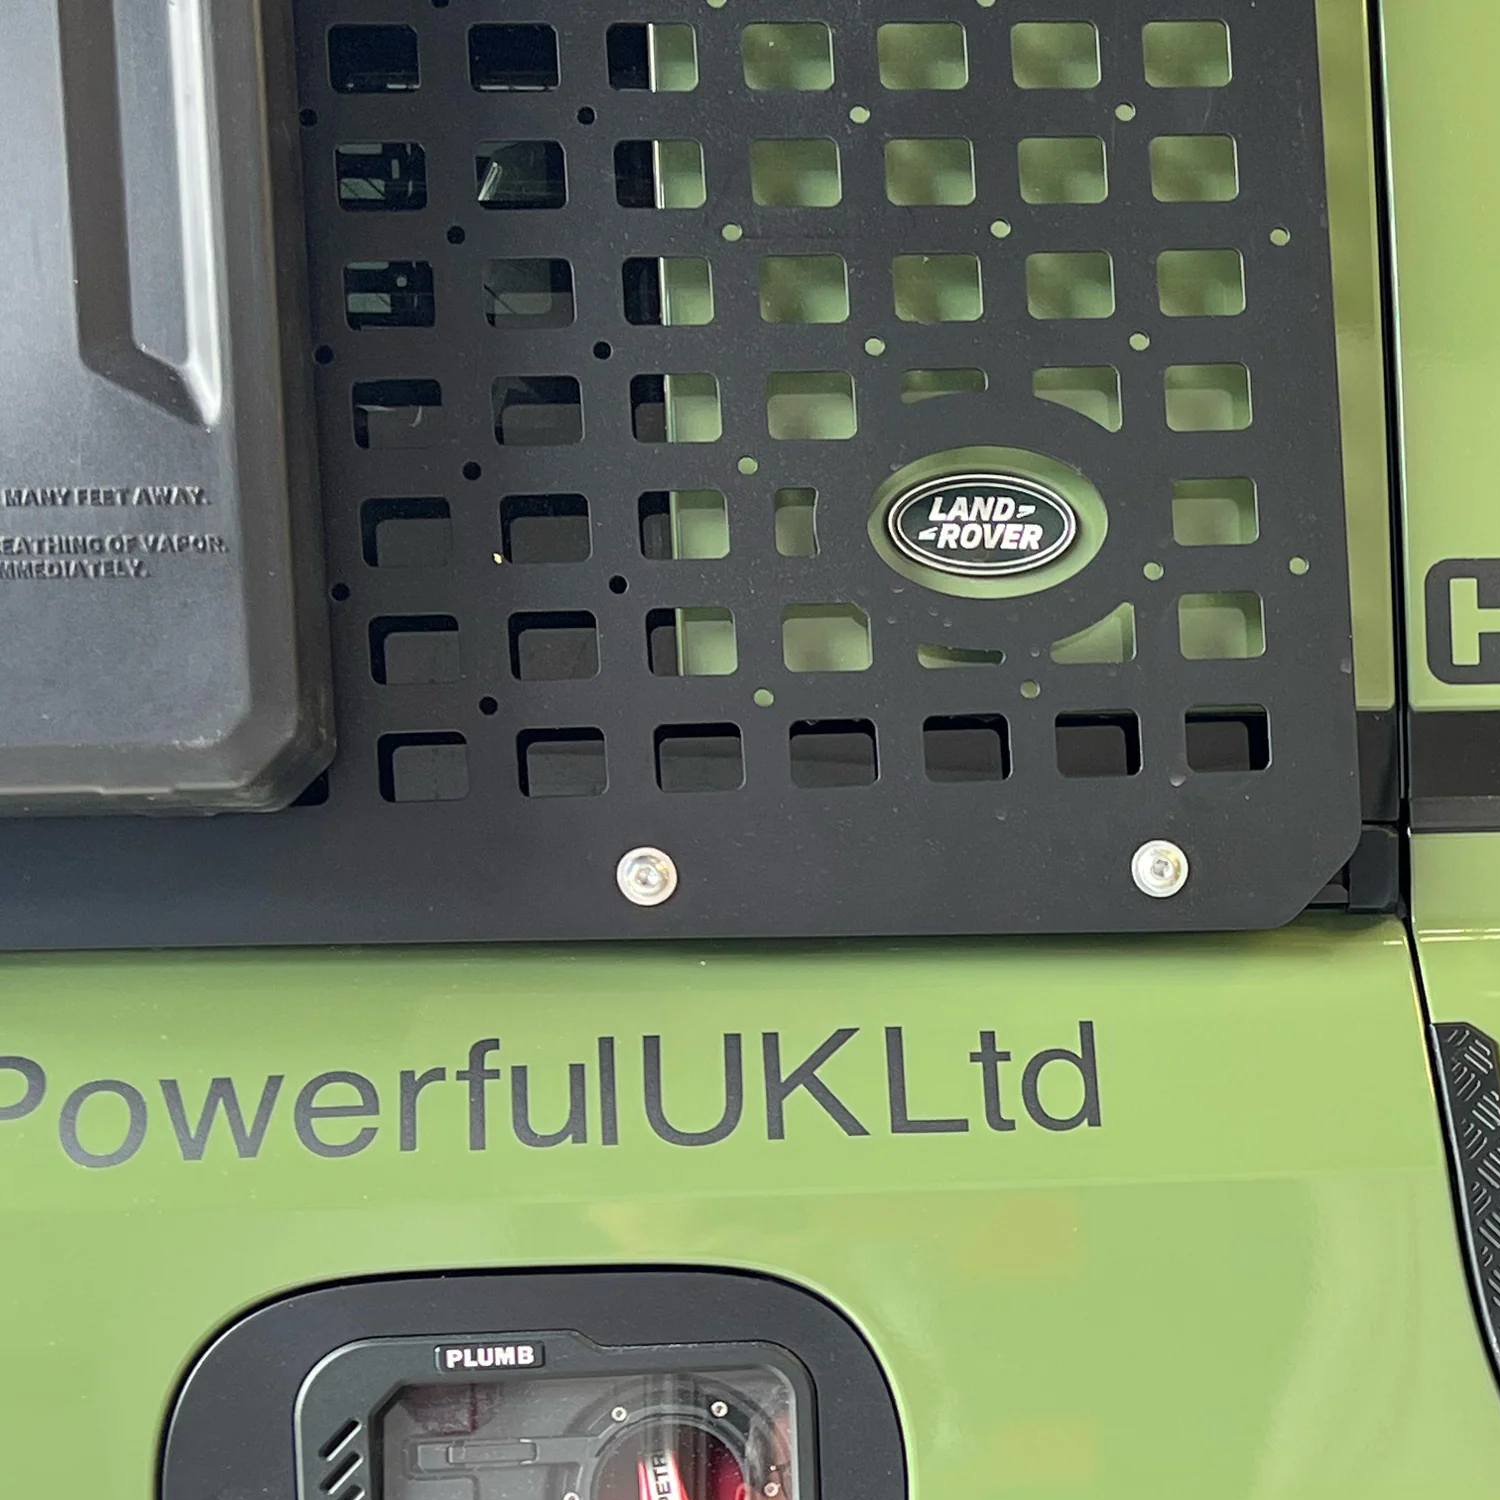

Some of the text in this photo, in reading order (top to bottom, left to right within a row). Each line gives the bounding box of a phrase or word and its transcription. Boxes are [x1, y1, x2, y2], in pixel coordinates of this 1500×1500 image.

[1, 486, 212, 507] MANY FEET AWAY.
[928, 496, 1016, 522] LAND
[104, 535, 138, 554] OF
[139, 533, 230, 554] VAPOR.
[937, 523, 1043, 550] ROVER
[445, 1345, 535, 1369] PLUMB
